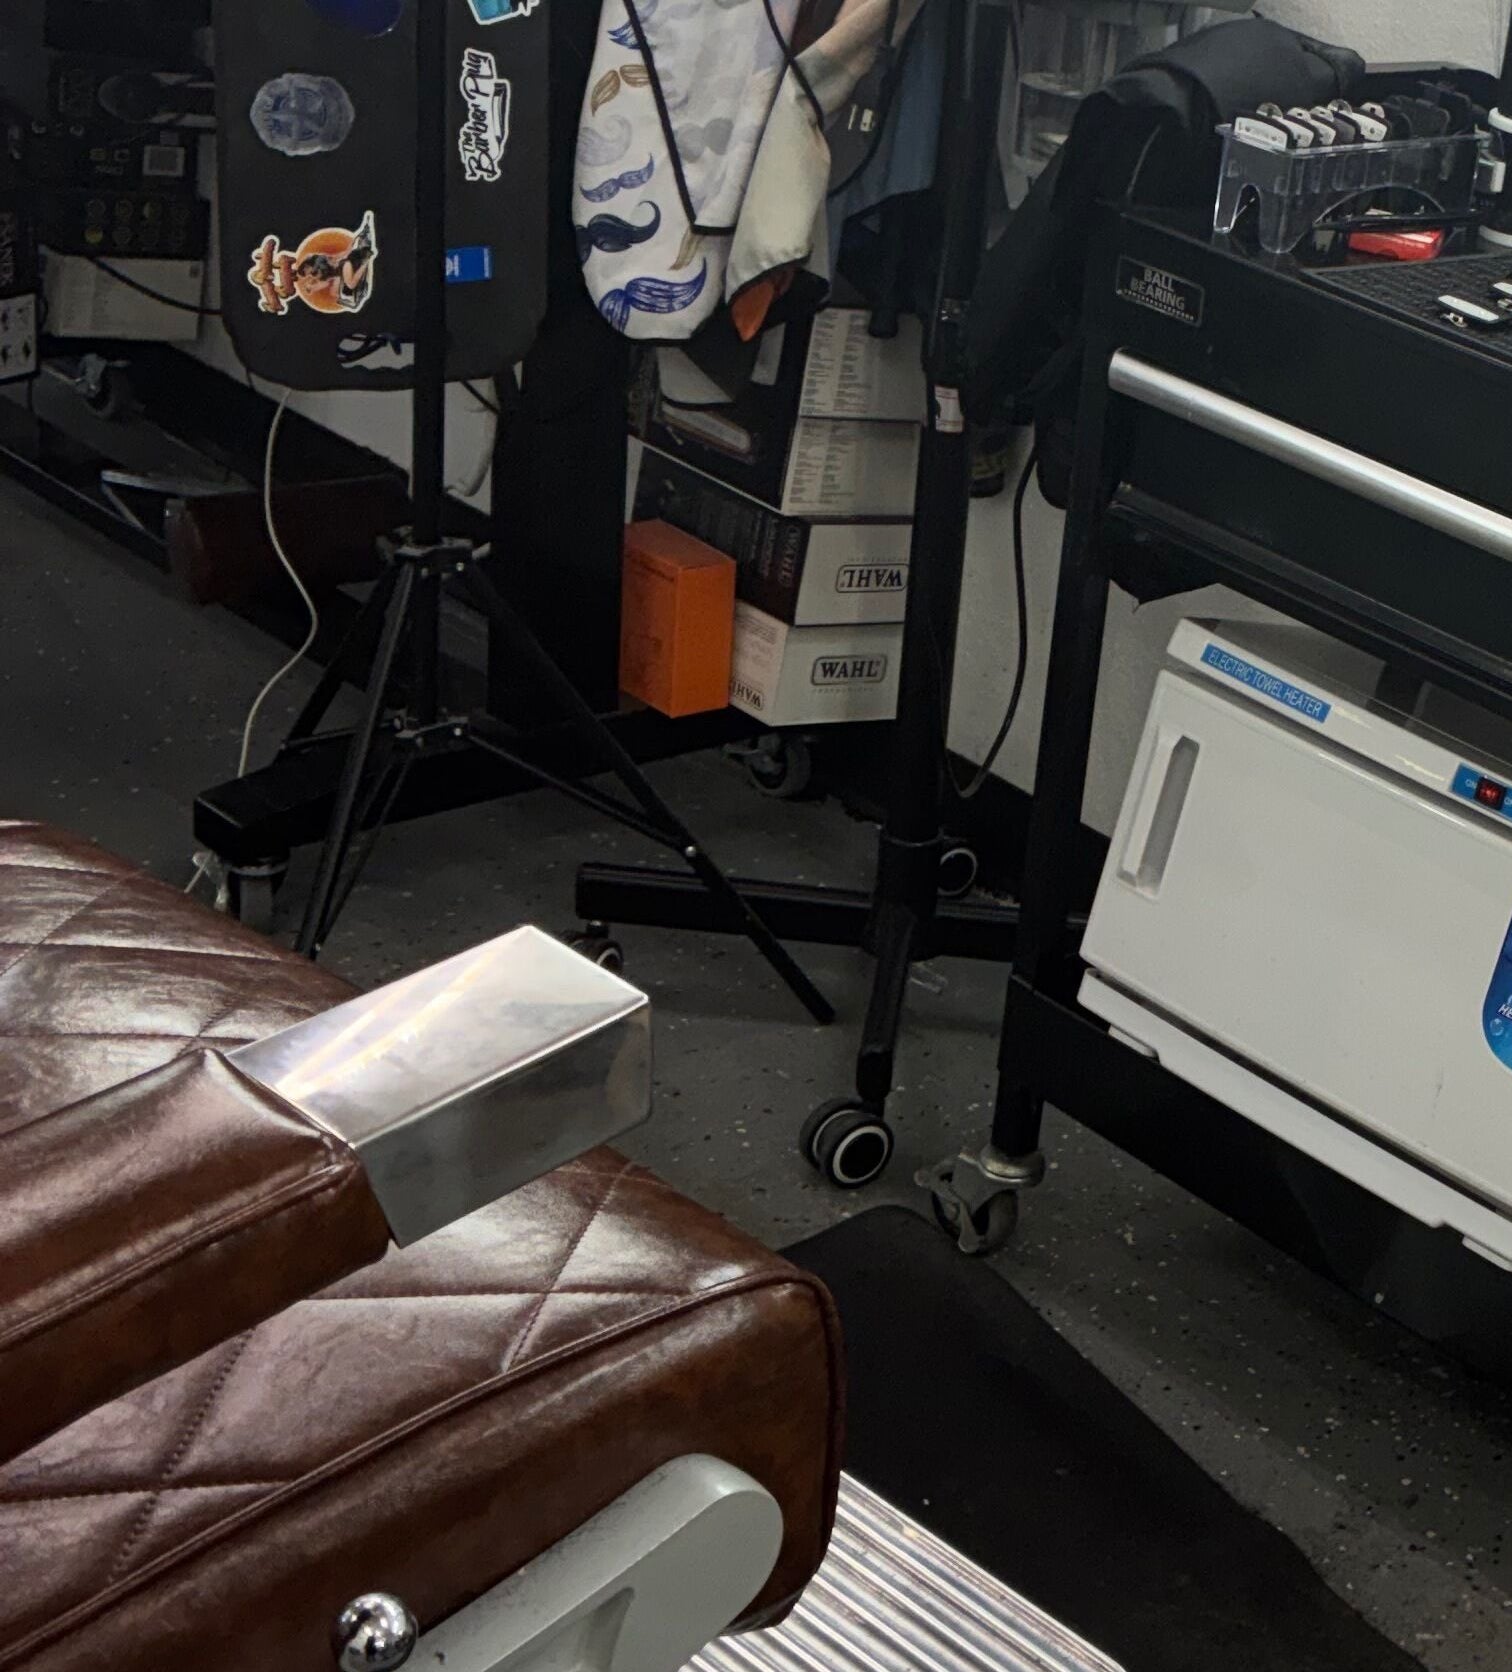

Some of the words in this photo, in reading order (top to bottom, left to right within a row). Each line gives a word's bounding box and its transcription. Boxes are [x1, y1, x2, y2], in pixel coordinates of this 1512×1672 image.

[463, 51, 494, 100] Plug
[467, 102, 498, 178] Barber
[1130, 276, 1185, 311] BEARING
[1143, 268, 1174, 292] BALL
[843, 569, 902, 588] WAHL
[820, 660, 879, 679] WAHL
[1208, 649, 1254, 683] ELECTRIC
[1250, 670, 1284, 699] TOWEL
[1285, 687, 1323, 717] HEATER
